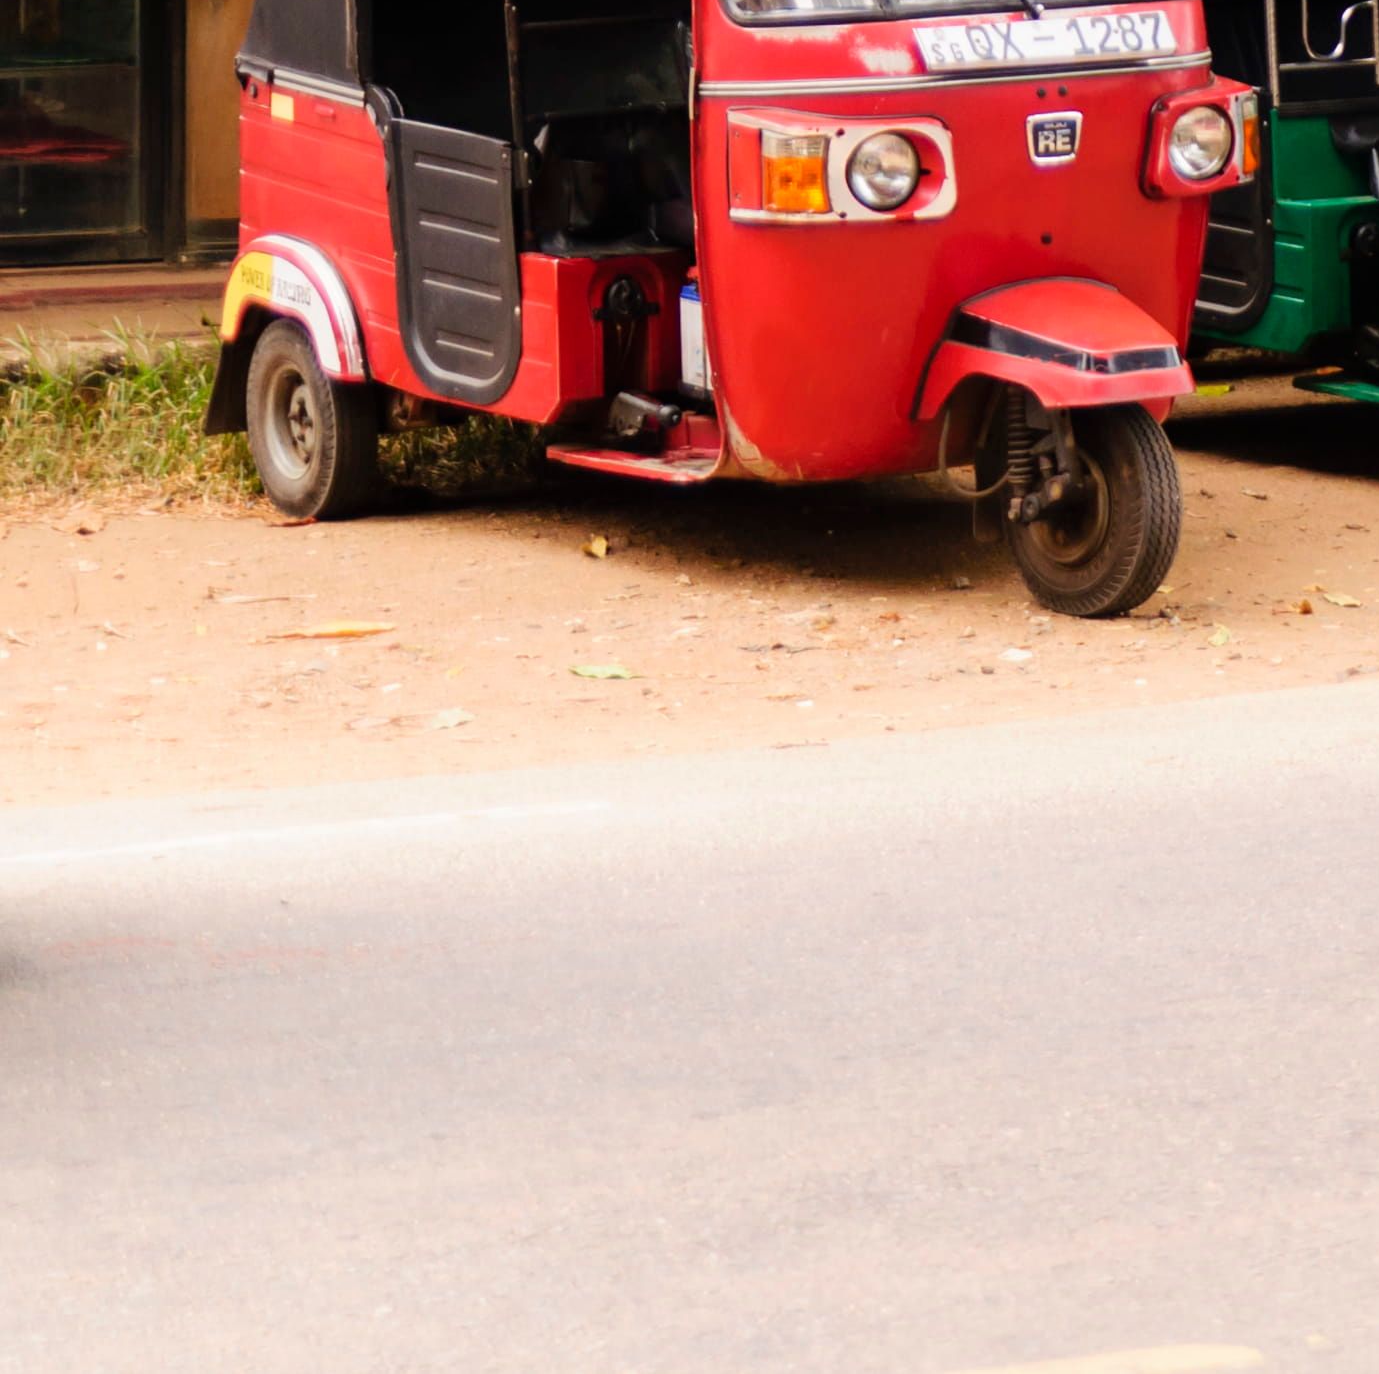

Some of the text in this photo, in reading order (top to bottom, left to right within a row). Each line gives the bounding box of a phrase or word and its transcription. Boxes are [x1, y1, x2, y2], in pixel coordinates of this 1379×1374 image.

[931, 42, 965, 64] SG
[965, 22, 1024, 60] QX
[1066, 12, 1162, 56] 1287
[1037, 128, 1072, 154] RE
